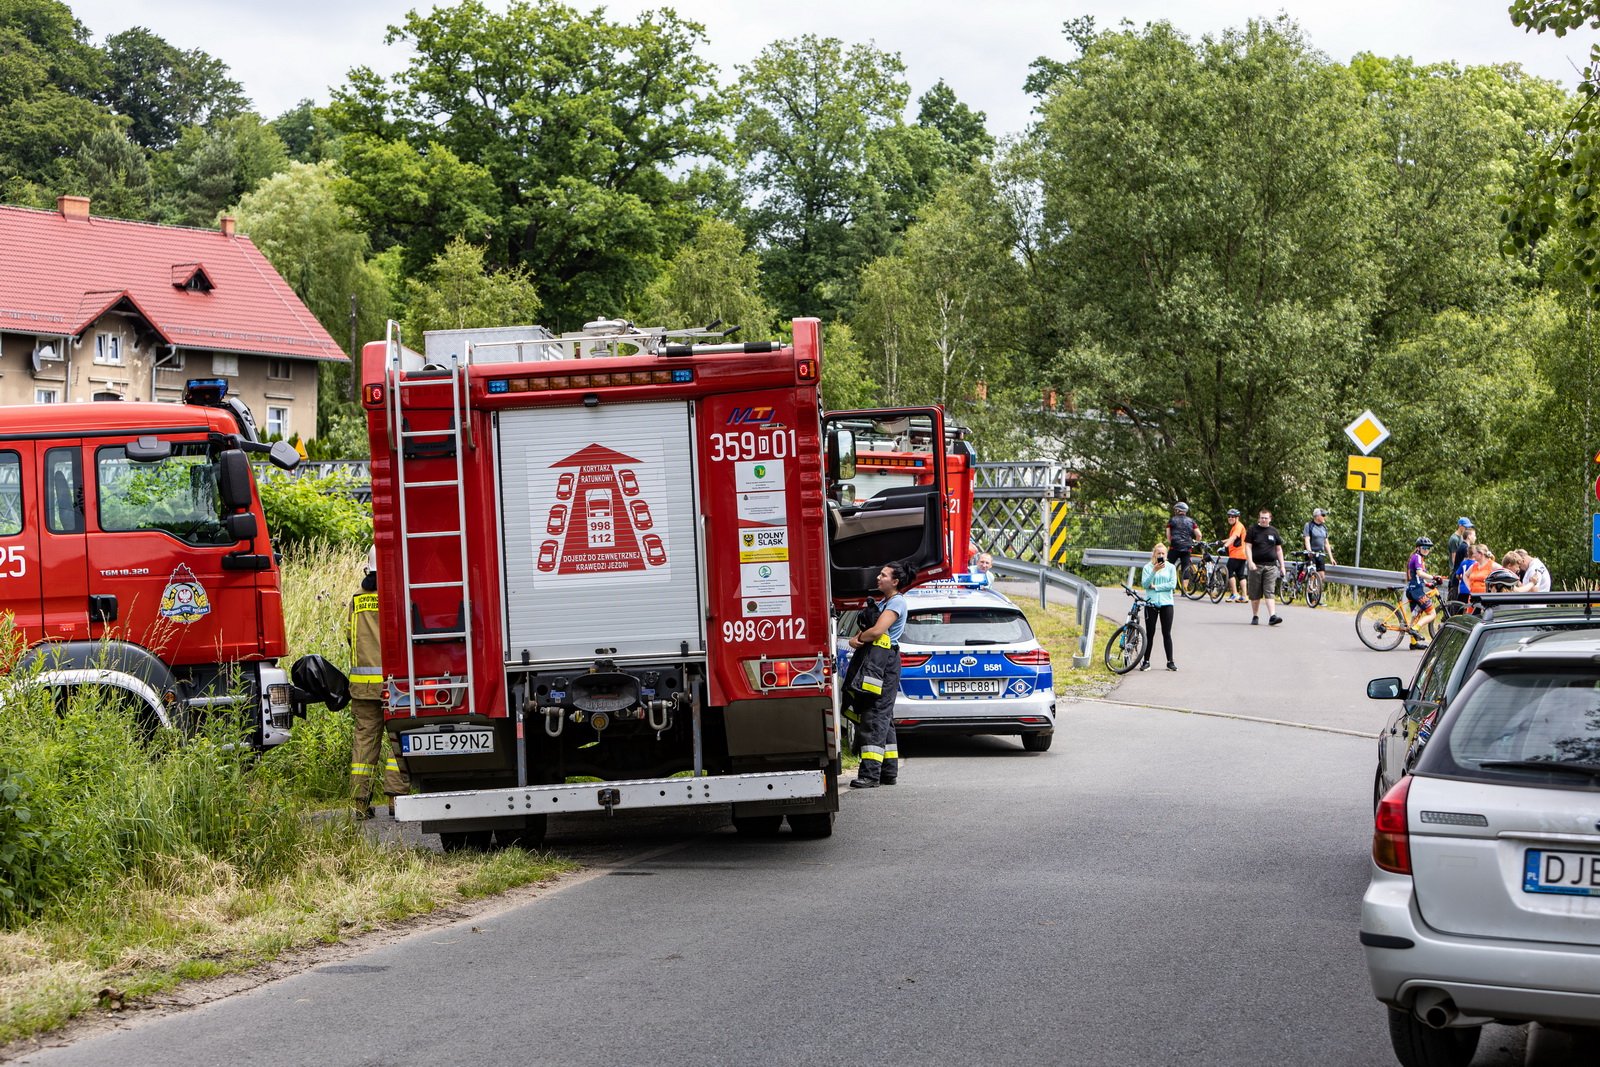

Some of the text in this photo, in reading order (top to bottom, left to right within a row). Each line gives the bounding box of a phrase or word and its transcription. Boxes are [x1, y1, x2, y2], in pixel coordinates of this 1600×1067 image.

[582, 464, 611, 473] KORYTARZ
[580, 474, 614, 483] RATUNKOWY
[590, 521, 611, 531] 998
[591, 533, 612, 543] 112
[757, 531, 785, 540] DOLNY
[587, 553, 597, 561] DO
[597, 551, 641, 562] ZEWNĘTRZNEJ
[575, 561, 629, 571] KRAWĘDZI JEZDNI
[119, 568, 150, 576] 18.320
[722, 619, 756, 643] 998
[776, 617, 806, 640] 112
[925, 663, 964, 674] POLICJA
[983, 663, 1002, 672] B581
[946, 681, 966, 692] HPB
[970, 681, 995, 692] C881
[412, 733, 490, 751] DJE 99N2
[1526, 872, 1538, 881] PL
